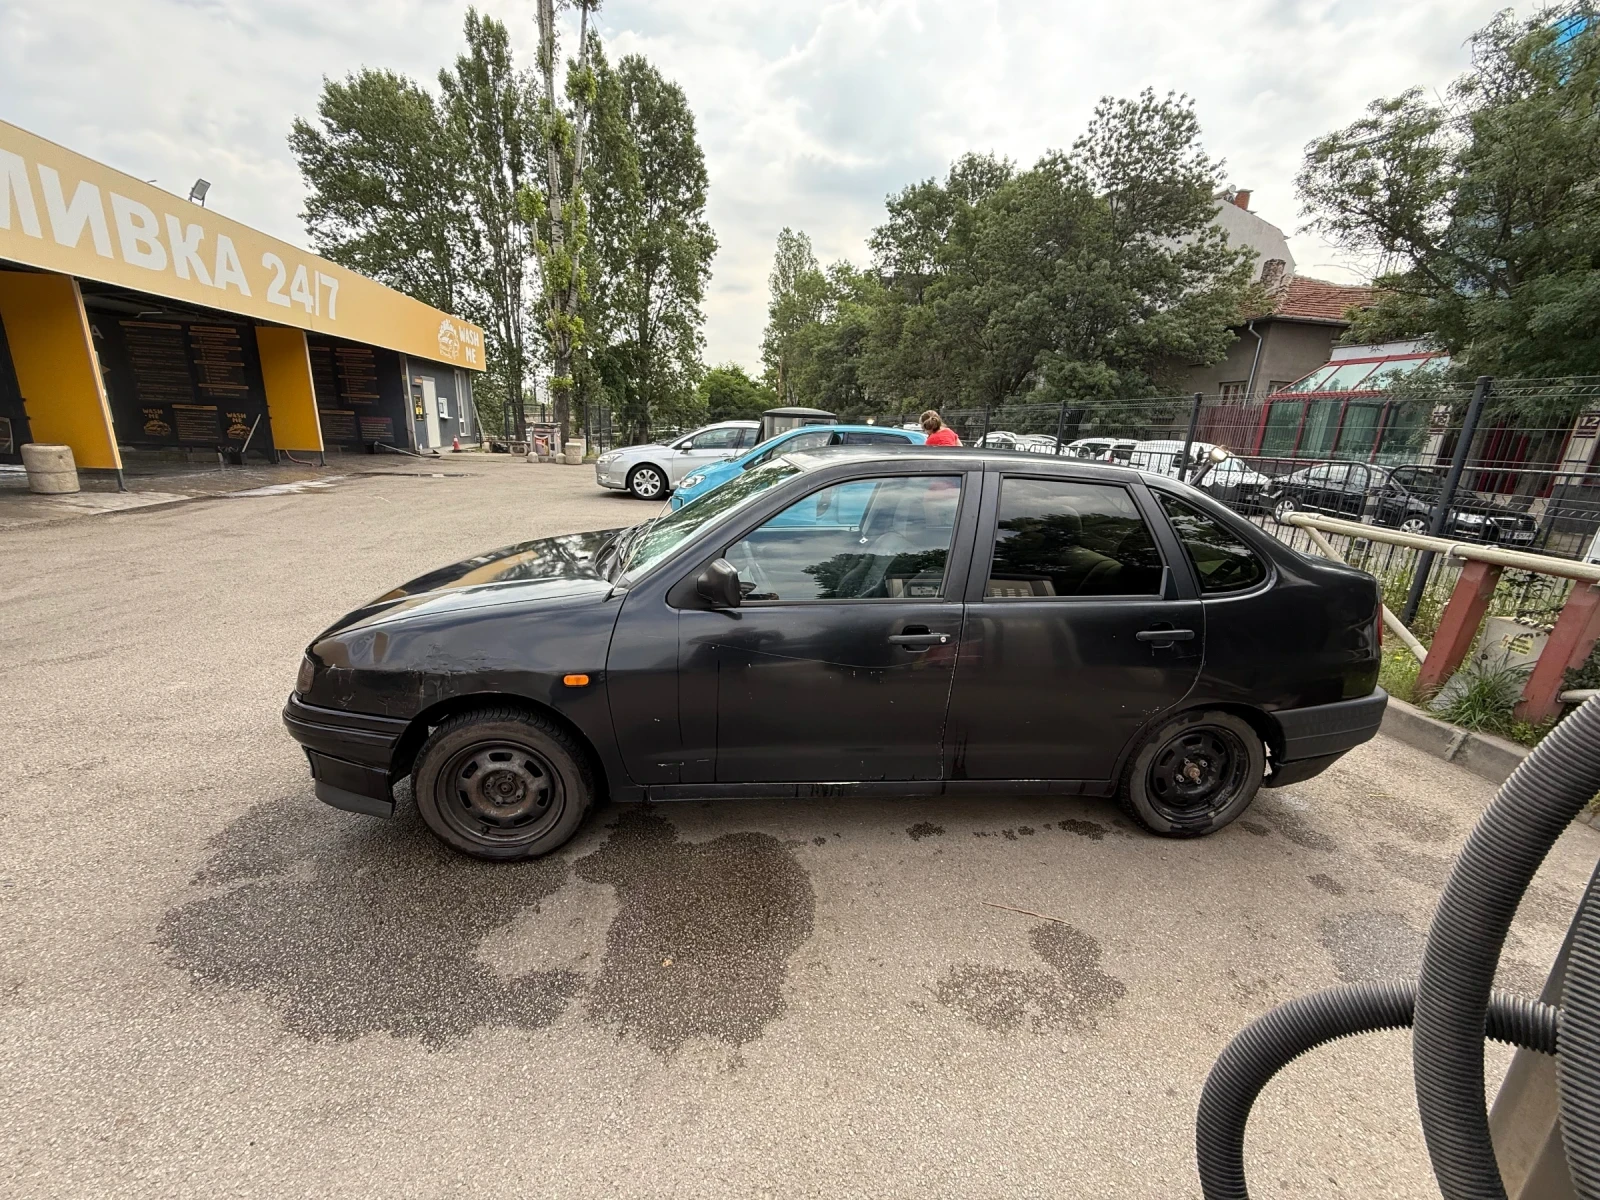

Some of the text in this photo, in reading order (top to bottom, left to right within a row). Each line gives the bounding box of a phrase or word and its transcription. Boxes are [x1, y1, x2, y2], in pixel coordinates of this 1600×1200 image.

[262, 252, 339, 320] 24/7
[459, 326, 479, 346] WASH
[466, 347, 476, 363] ME
[1581, 416, 1600, 427] 12
